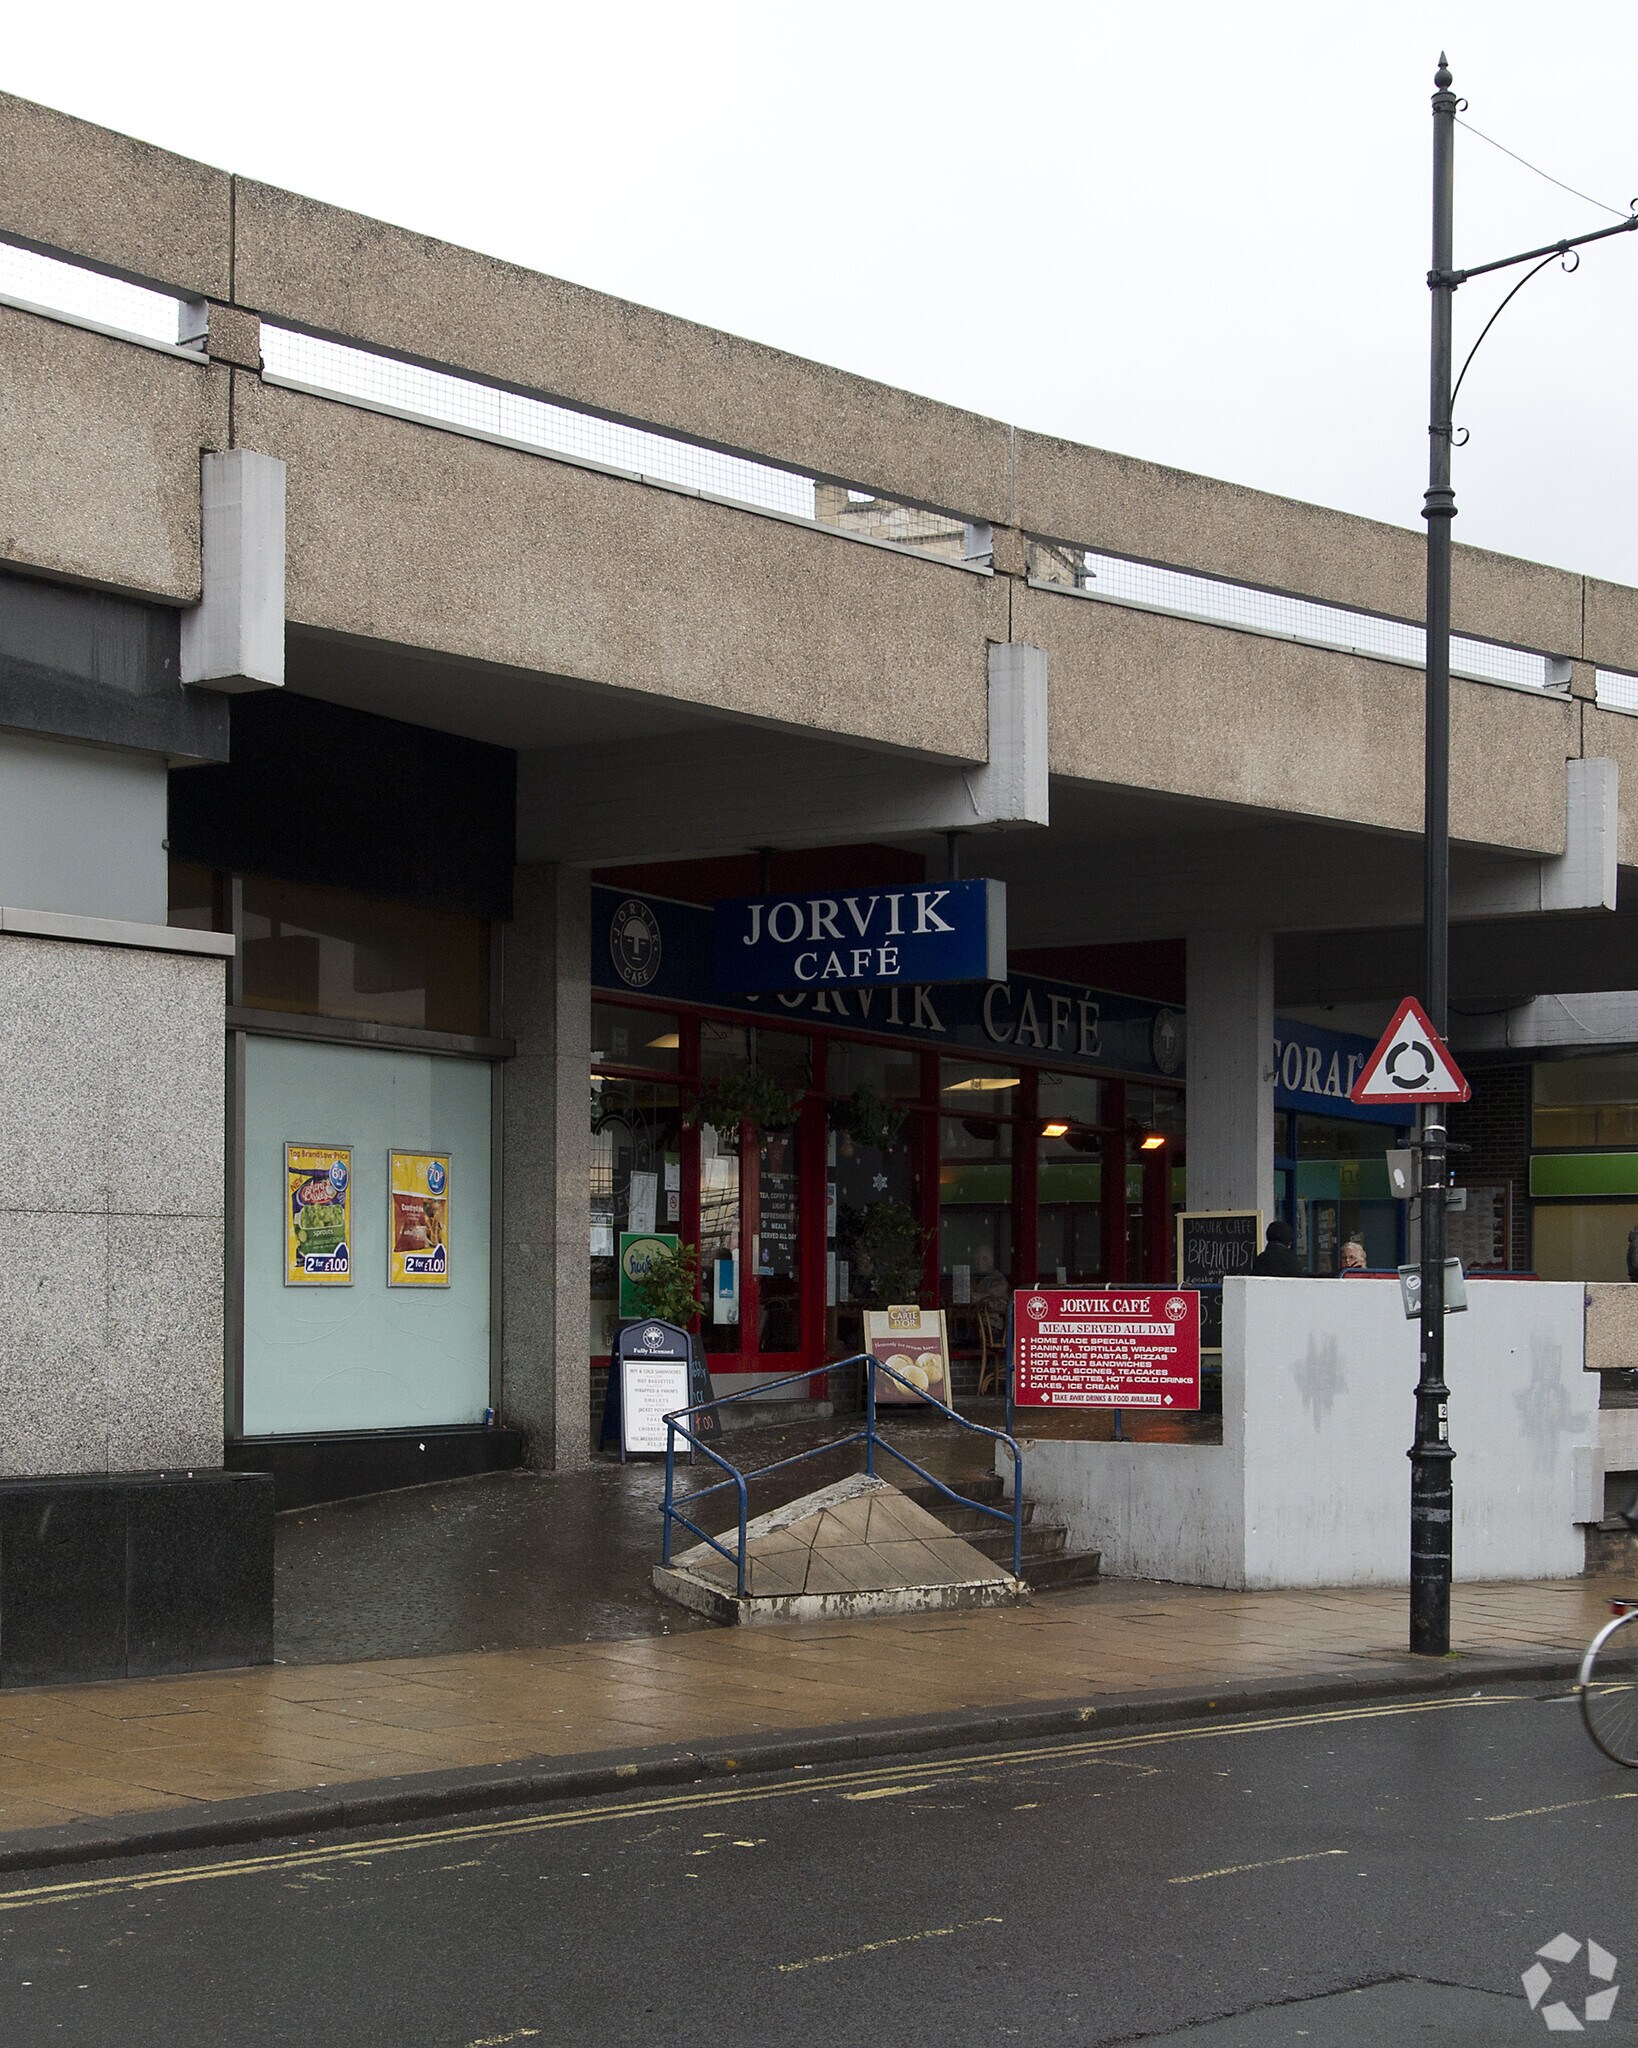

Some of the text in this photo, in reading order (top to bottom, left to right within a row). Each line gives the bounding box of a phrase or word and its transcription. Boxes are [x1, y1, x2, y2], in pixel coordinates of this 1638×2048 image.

[613, 903, 659, 943] JORVIK
[743, 890, 955, 945] JORVIK
[794, 941, 900, 981] CAFÉ
[983, 982, 1102, 1057] CAFÉ
[1188, 1238, 1257, 1271] BREAKFAST
[306, 1257, 348, 1272] 2 for £1.00
[406, 1258, 445, 1272] 2 for £1.00
[1060, 1299, 1109, 1313] JORVIK
[1112, 1296, 1150, 1313] CAFÉ
[890, 1311, 918, 1320] CARTE
[894, 1319, 917, 1328] D'OR
[1042, 1323, 1171, 1334] MEAL SERVED ALL DAY
[633, 1347, 648, 1355] Fully
[1090, 1353, 1131, 1361] PASTAS,
[1030, 1367, 1071, 1375] TOASTY,
[1073, 1368, 1115, 1376] SCONES,
[1050, 1375, 1105, 1383] BAGUETTES,
[1030, 1382, 1065, 1390] CAKES,
[1086, 1394, 1106, 1402] DRINKS
